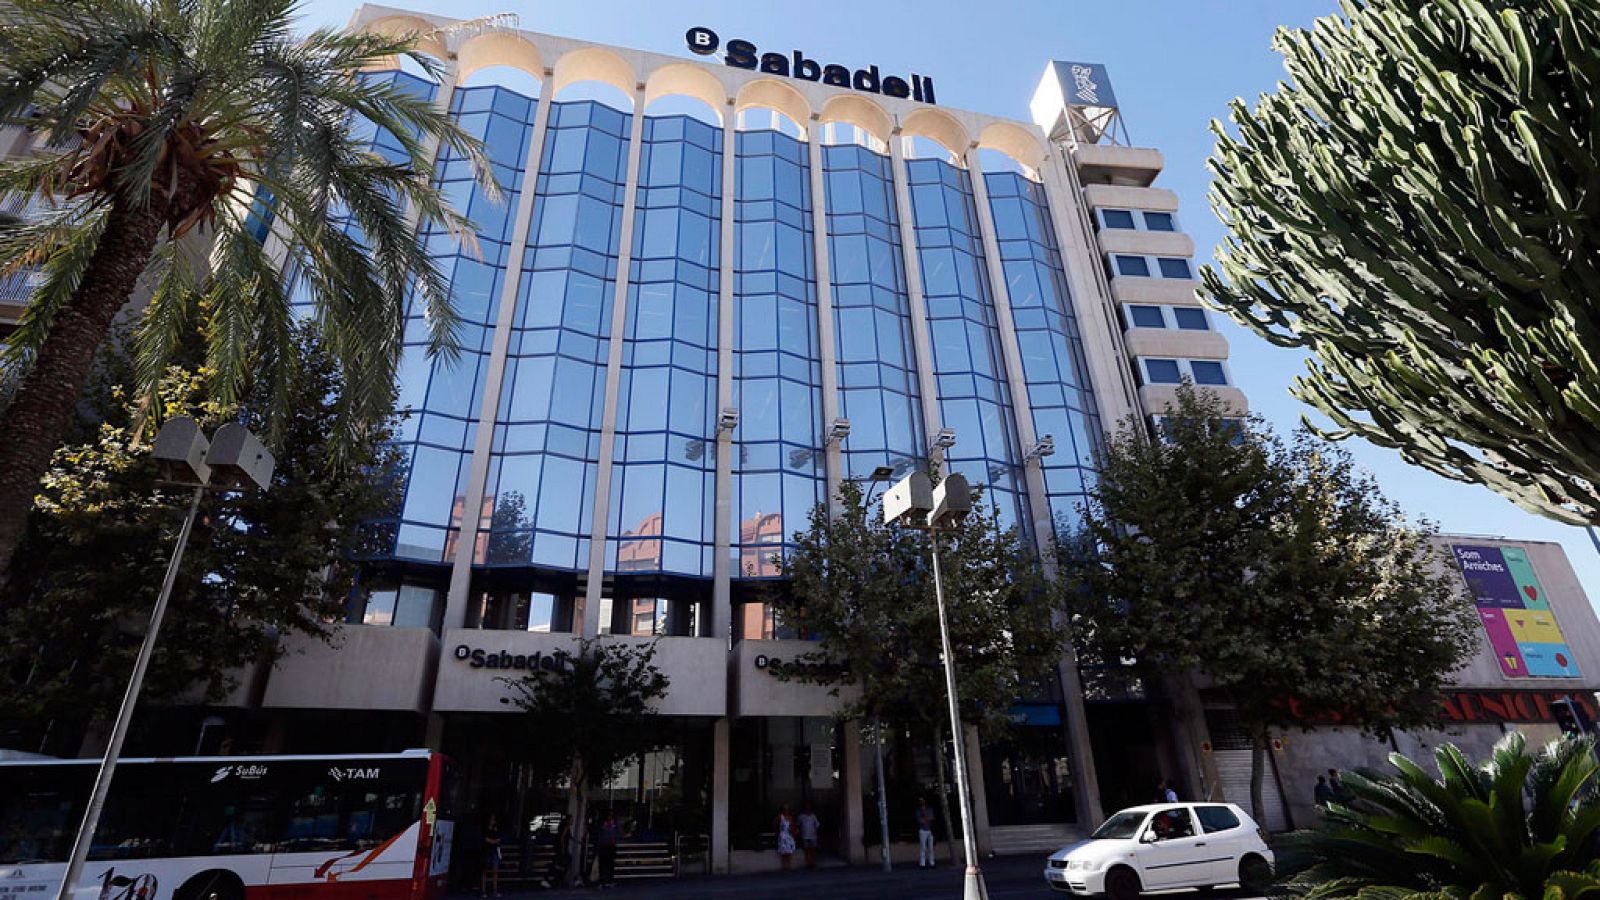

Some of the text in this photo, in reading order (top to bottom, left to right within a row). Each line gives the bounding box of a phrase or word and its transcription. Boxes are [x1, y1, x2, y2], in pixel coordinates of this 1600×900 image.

[725, 38, 936, 105] Sabadell
[1457, 548, 1480, 559] Som
[1463, 560, 1504, 572] Arniches
[346, 768, 380, 779] TAM
